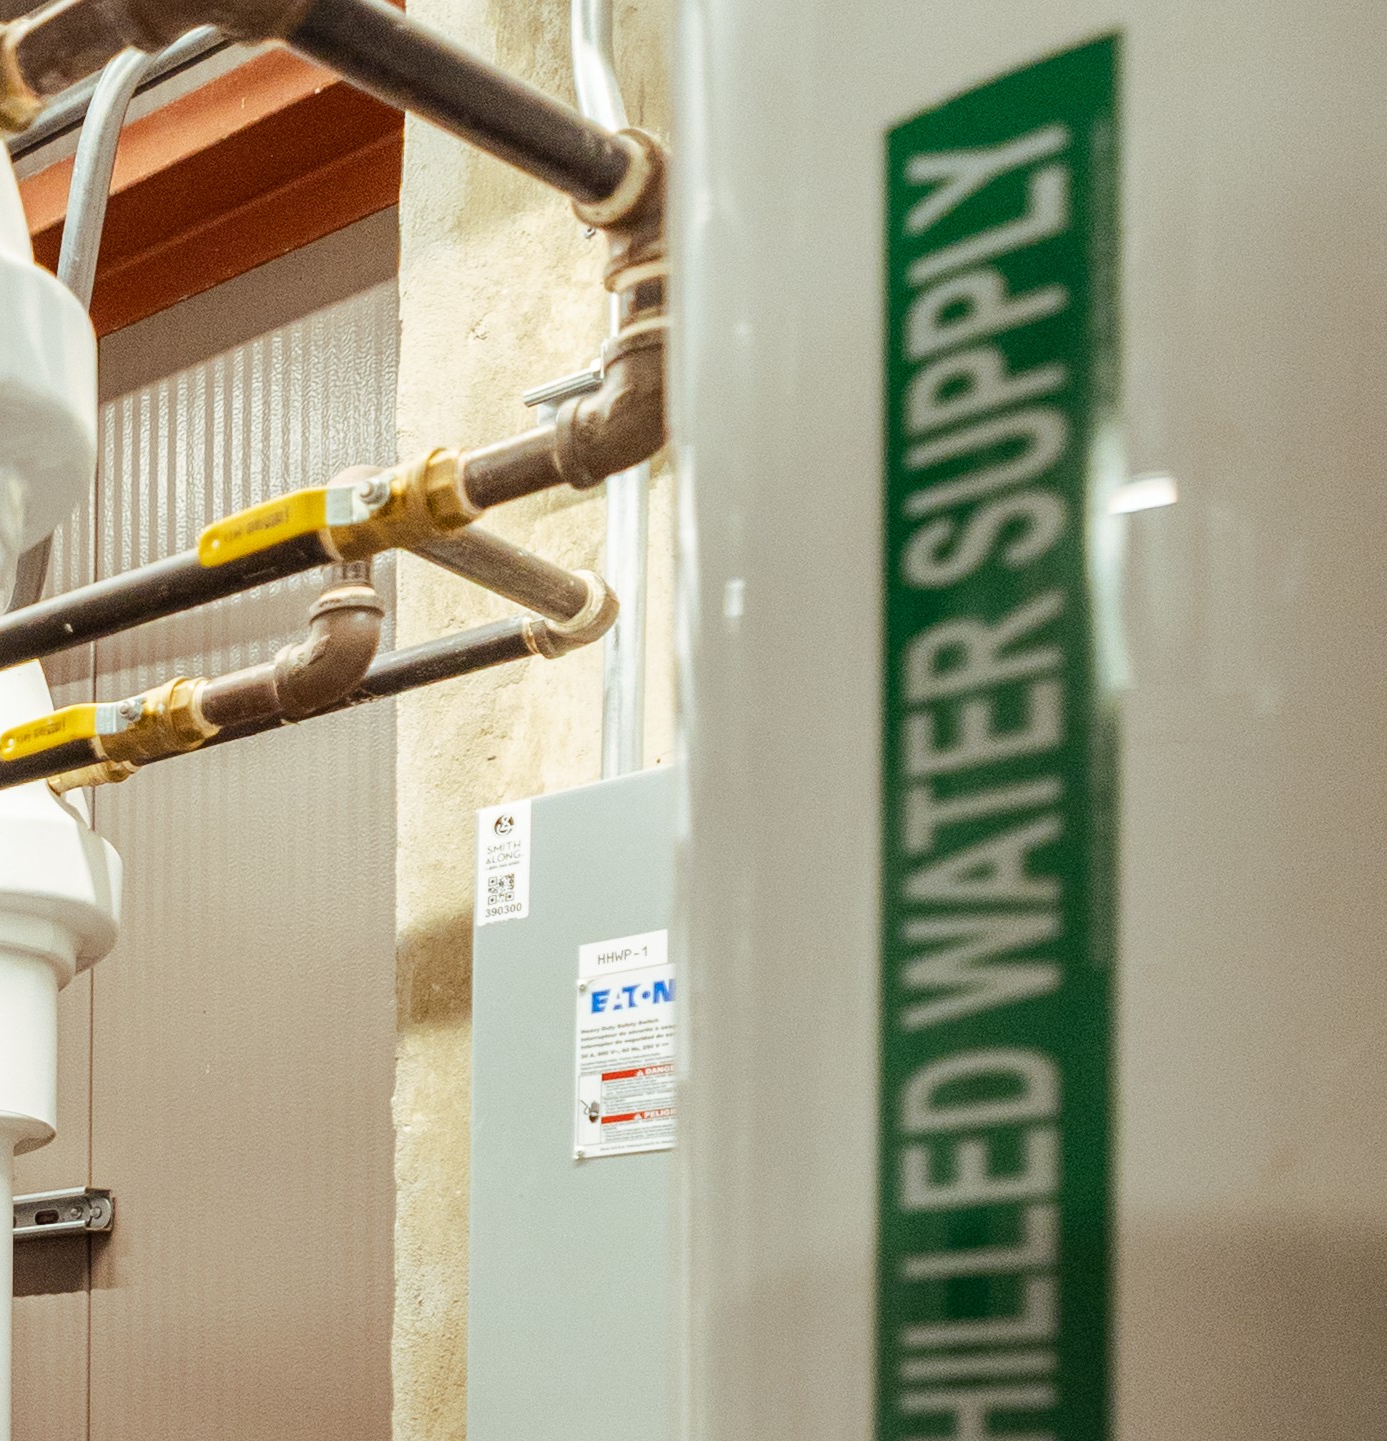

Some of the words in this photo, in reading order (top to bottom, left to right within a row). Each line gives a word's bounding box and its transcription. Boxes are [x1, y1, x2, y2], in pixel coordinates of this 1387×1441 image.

[904, 122, 1071, 590] SUPPLY
[898, 590, 1066, 1032] WATER
[487, 840, 522, 855] SMITH
[485, 902, 522, 918] 390300
[597, 946, 649, 965] HHWP-1
